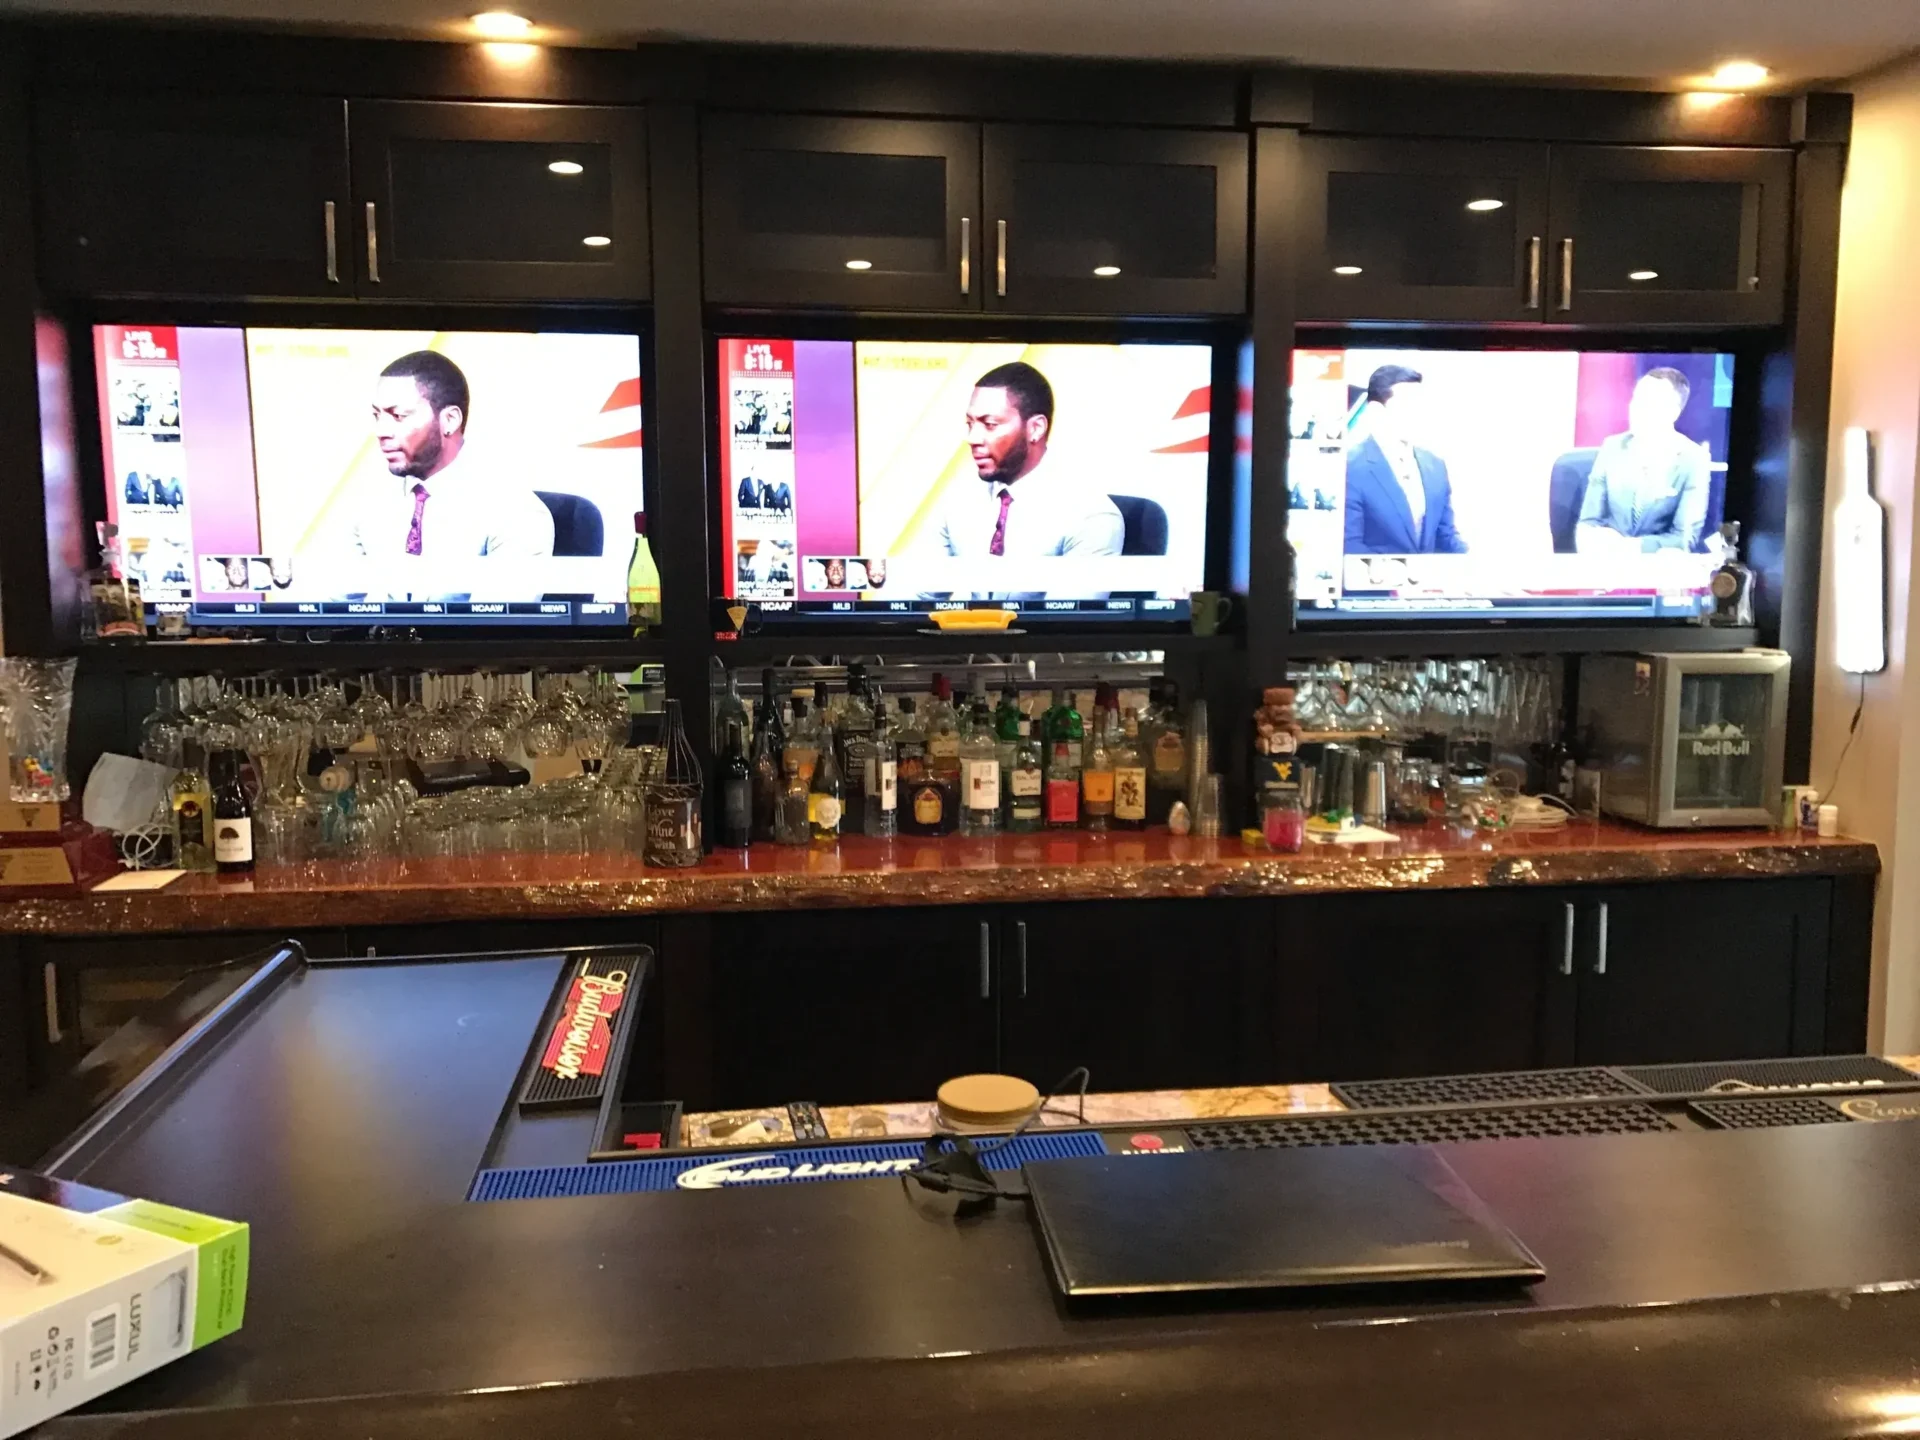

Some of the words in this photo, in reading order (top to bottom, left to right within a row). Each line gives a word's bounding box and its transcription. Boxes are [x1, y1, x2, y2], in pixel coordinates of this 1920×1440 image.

[234, 604, 256, 613] MLB
[298, 604, 318, 613] NHL
[348, 604, 381, 613] NCAAM
[423, 604, 443, 613] NBA
[471, 604, 504, 613] NCAAW
[540, 604, 566, 613] NEWS
[581, 603, 616, 614] ESPN
[760, 601, 793, 611] NCAAF
[832, 602, 851, 611] MLB
[890, 602, 908, 611] NHL
[935, 602, 965, 611] NCAAM
[1002, 601, 1020, 610] NBA
[1046, 601, 1075, 610] NCAAW
[1107, 601, 1131, 610] NEWS
[1144, 601, 1176, 610] ESPN
[1692, 740, 1720, 756] Red
[1722, 740, 1750, 756] Bull
[554, 957, 628, 1080] Budweiser
[791, 1158, 920, 1177] LIGHT
[127, 1293, 142, 1362] LUXUL
